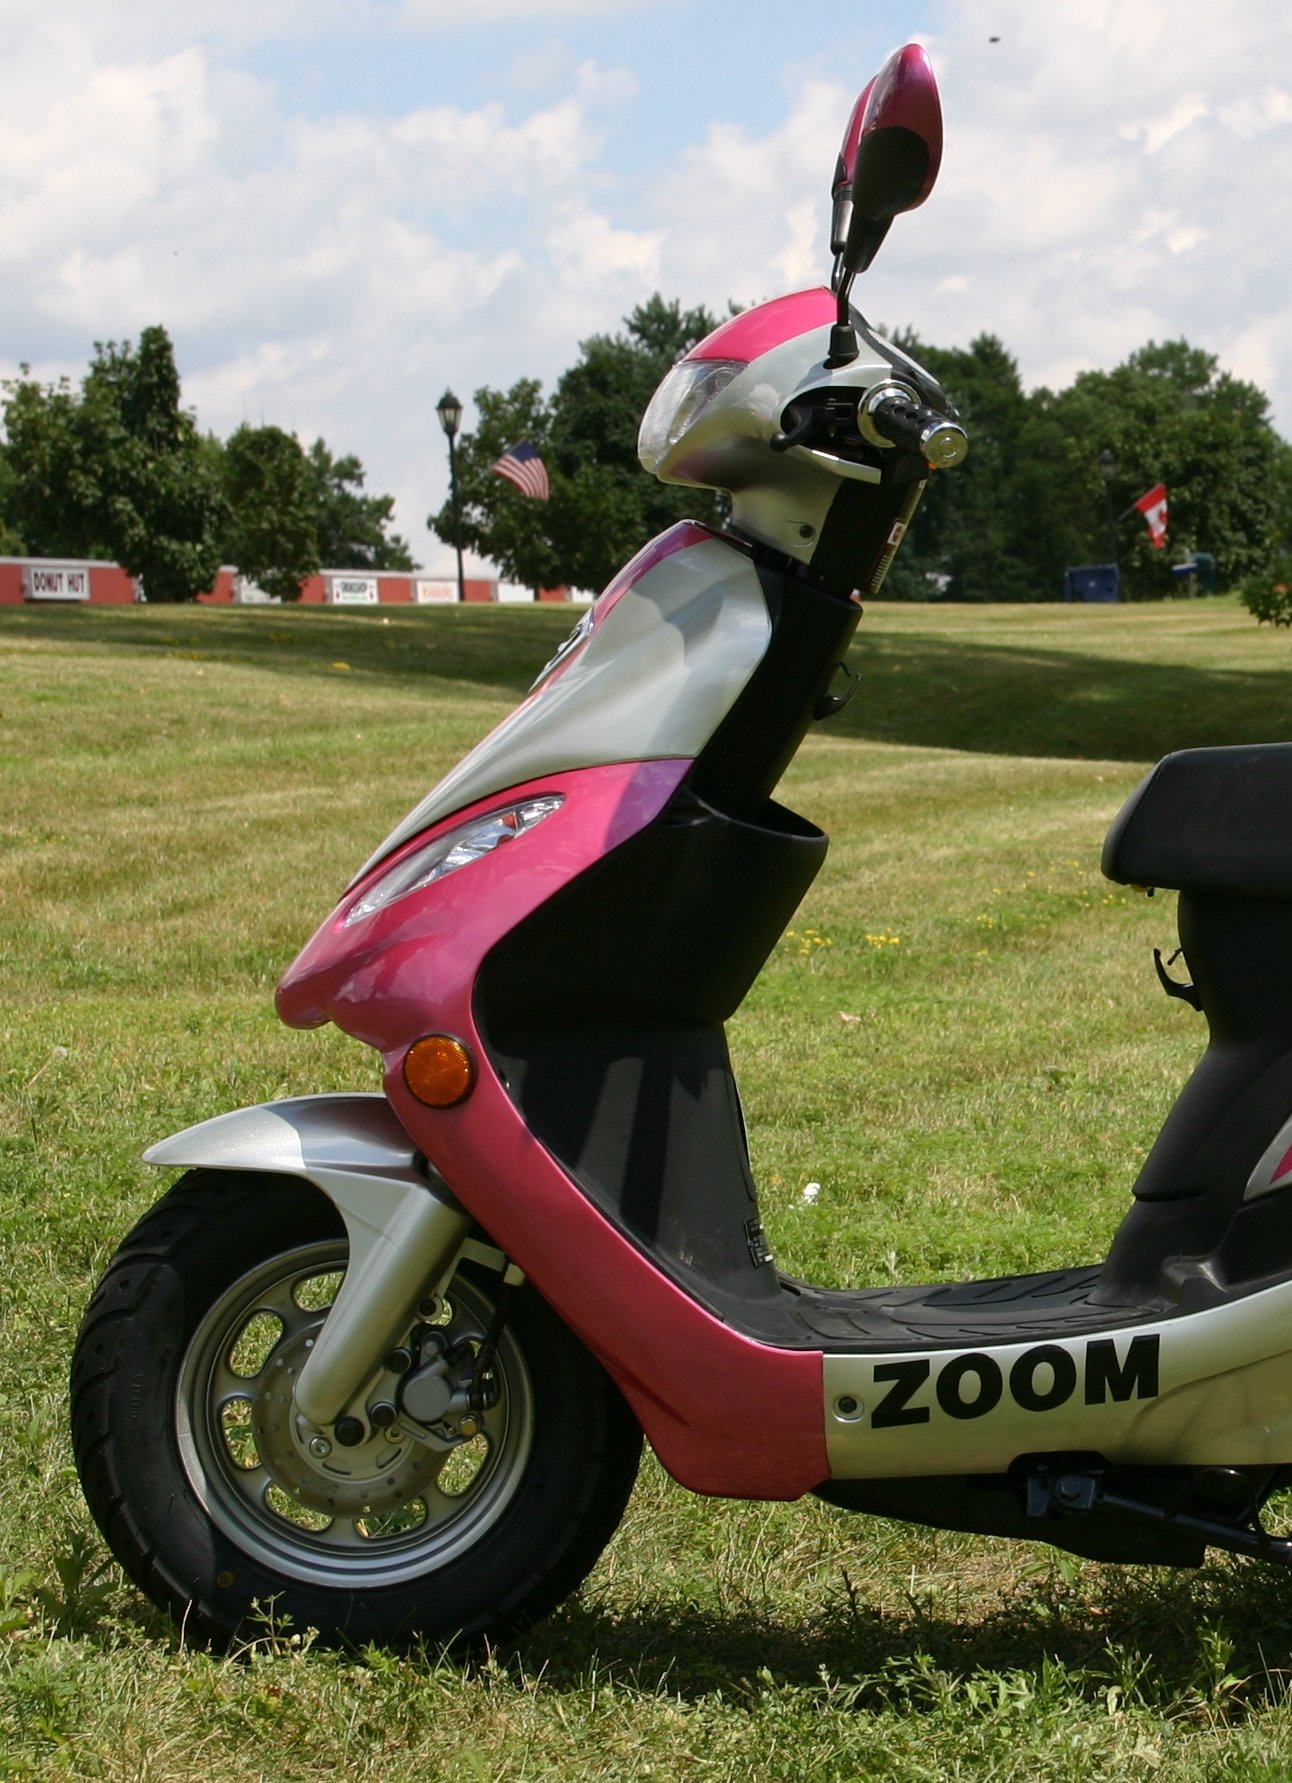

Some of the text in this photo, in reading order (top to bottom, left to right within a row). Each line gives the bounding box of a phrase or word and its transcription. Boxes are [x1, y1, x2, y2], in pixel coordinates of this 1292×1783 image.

[33, 571, 85, 593] DONUT HUT
[870, 1333, 1161, 1429] ZOOM
